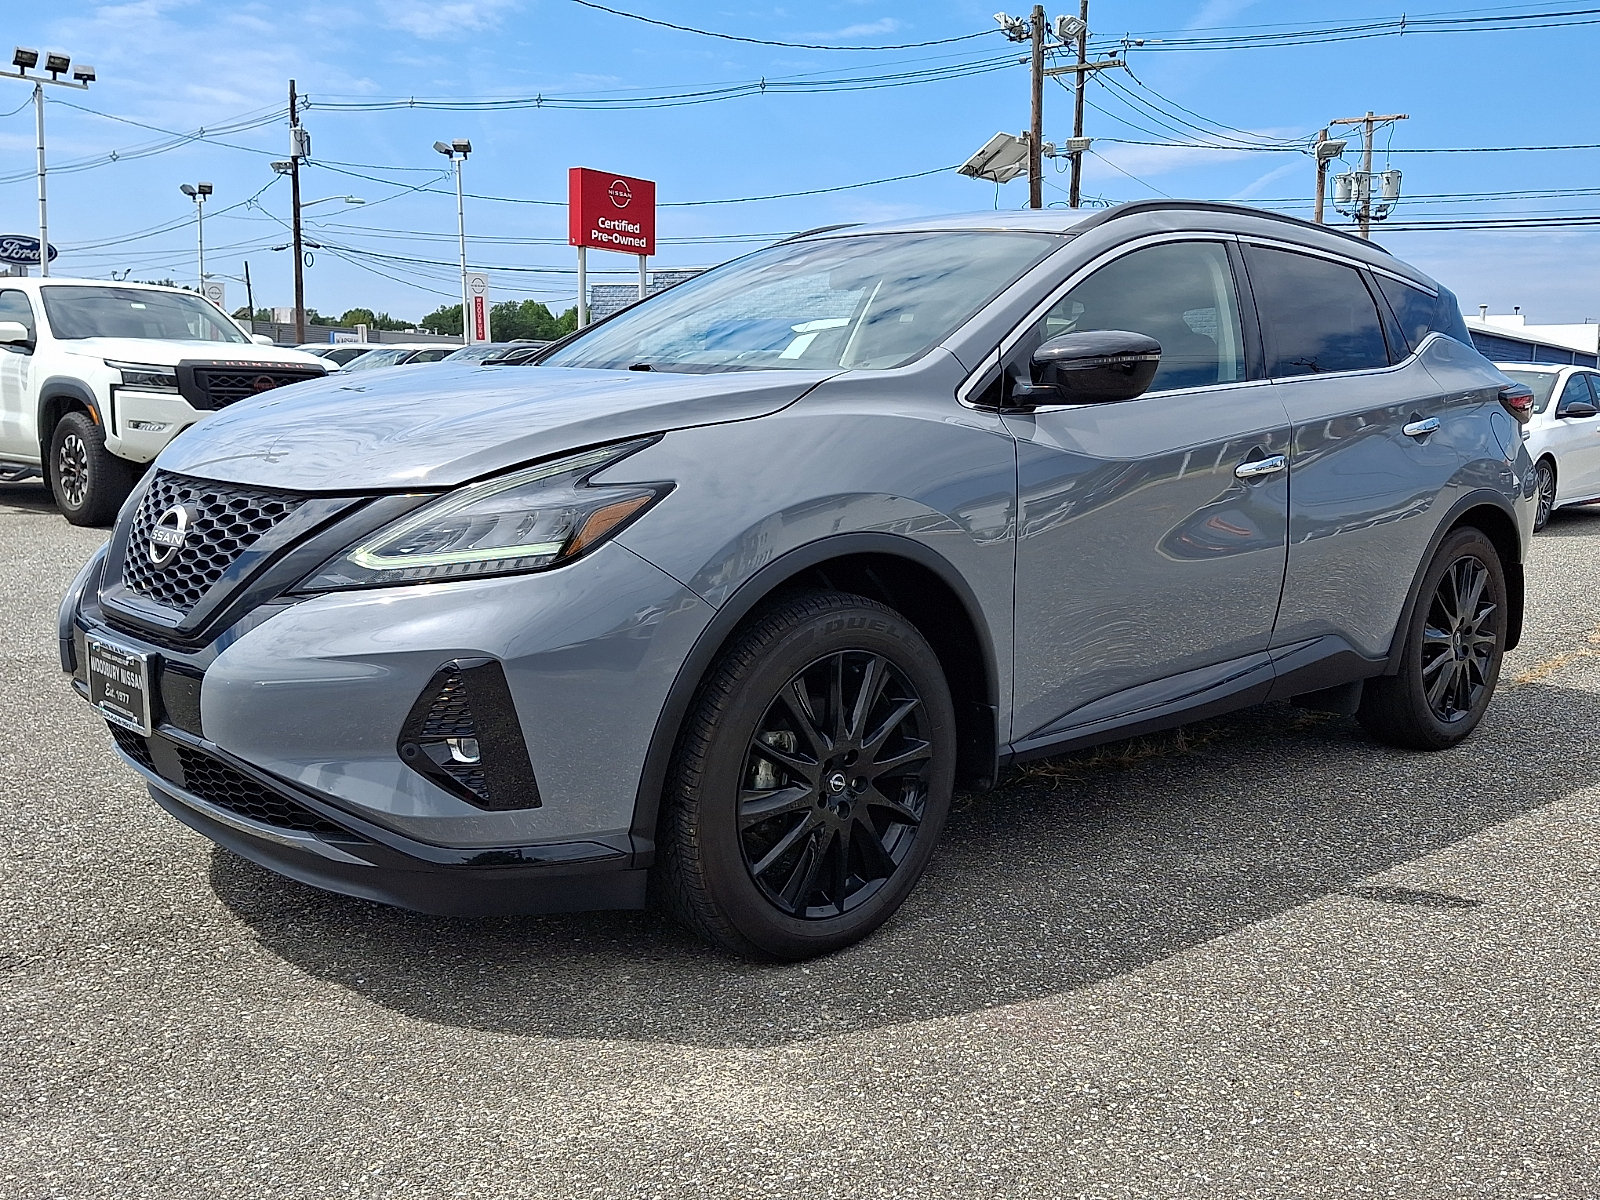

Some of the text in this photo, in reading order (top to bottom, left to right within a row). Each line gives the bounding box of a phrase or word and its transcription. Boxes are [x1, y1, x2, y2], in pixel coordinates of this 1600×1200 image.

[608, 189, 632, 199] NISSAN
[598, 217, 641, 234] Certified
[591, 229, 647, 248] Pre-Owned
[476, 298, 484, 339] WOODBURY
[151, 529, 184, 545] SSAN
[90, 655, 120, 682] WOODBURY
[120, 668, 143, 690] NISSAN
[115, 690, 130, 705] 1977
